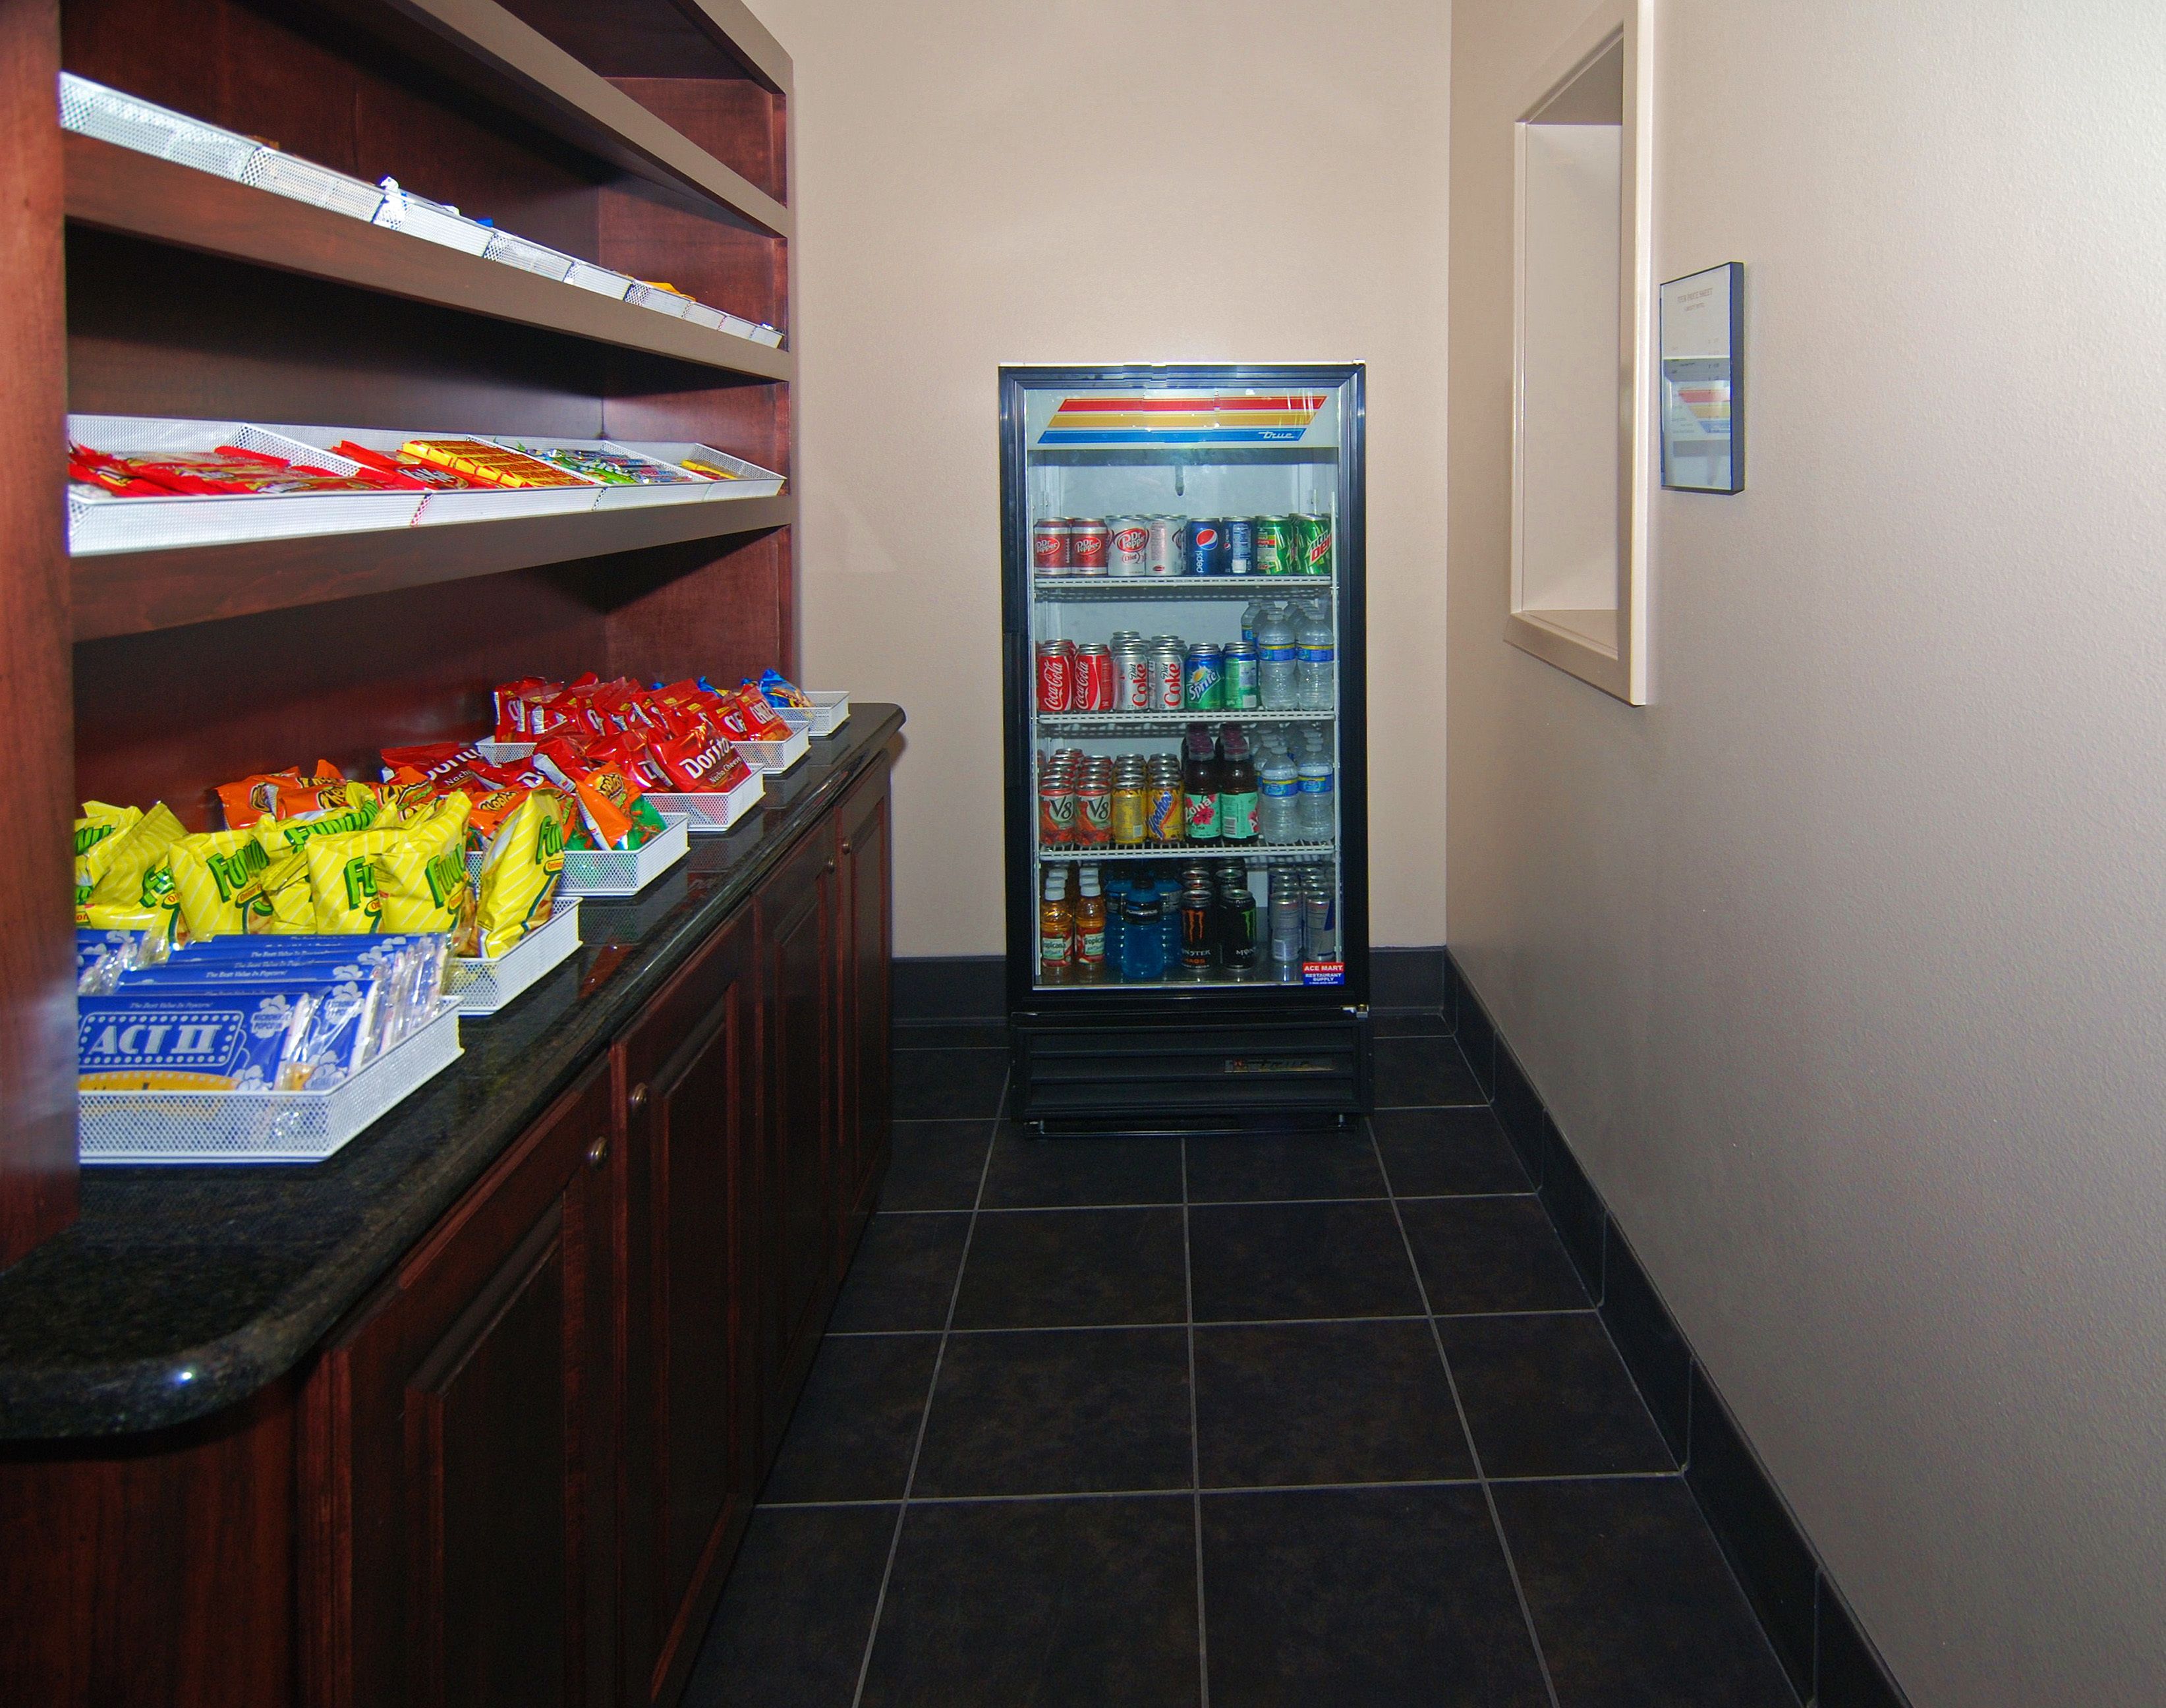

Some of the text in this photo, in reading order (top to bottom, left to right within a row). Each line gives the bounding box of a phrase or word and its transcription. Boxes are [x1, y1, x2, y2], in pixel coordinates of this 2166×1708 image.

[1131, 531, 1141, 540] Dr
[1195, 550, 1204, 573] pepsi
[1132, 664, 1147, 707] Coke
[1164, 664, 1182, 706] Coke
[1189, 671, 1218, 701] Sprite
[1050, 795, 1073, 820] V8
[1087, 795, 1110, 820] V8
[88, 1024, 223, 1055] ACT II
